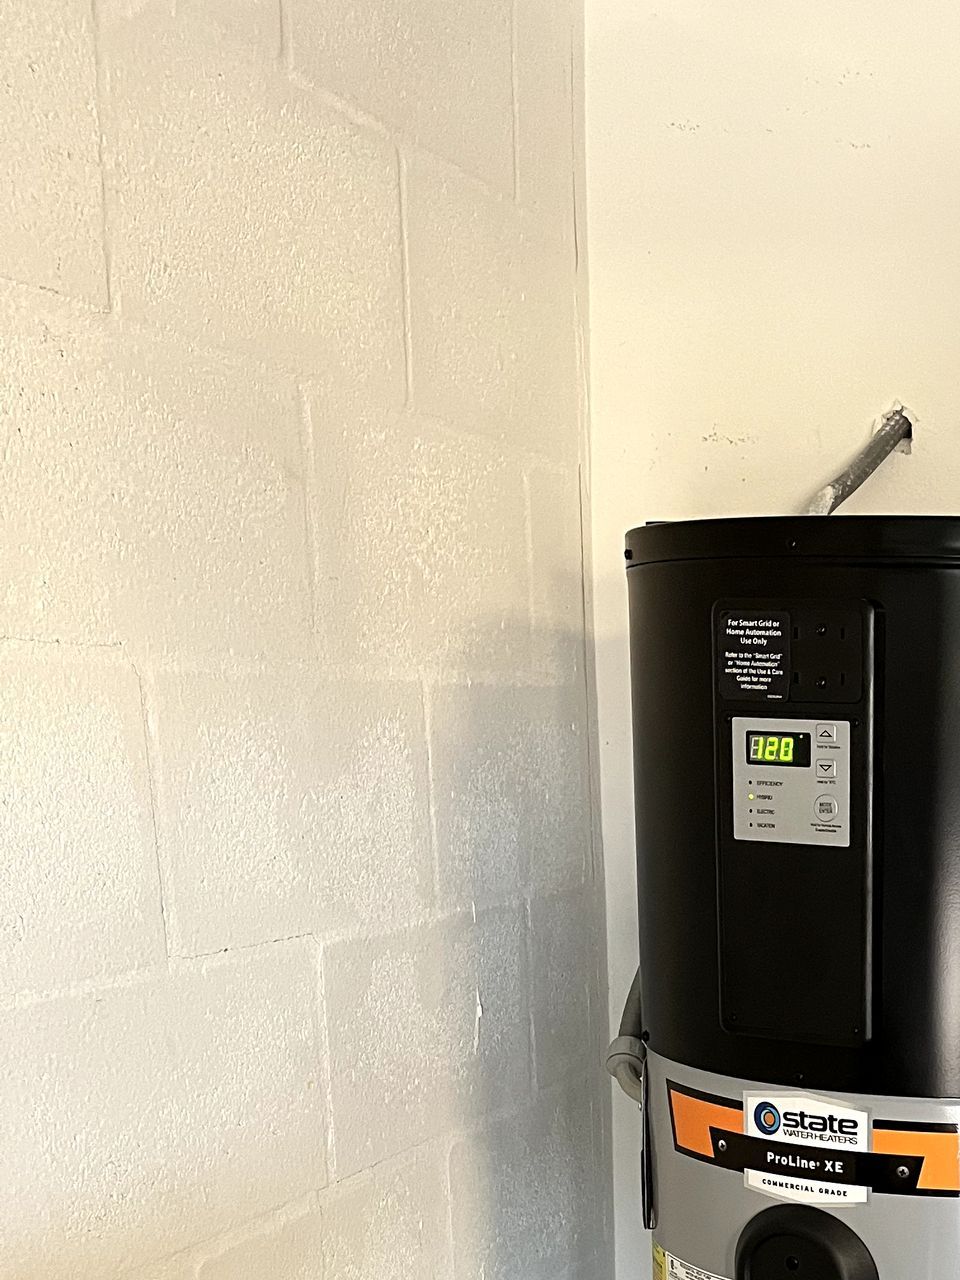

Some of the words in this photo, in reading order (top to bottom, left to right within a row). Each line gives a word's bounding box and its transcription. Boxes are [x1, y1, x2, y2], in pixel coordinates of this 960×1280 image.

[728, 619, 738, 627] For
[739, 619, 757, 627] Smart
[758, 619, 772, 627] Grid
[745, 628, 782, 636] Automation
[752, 637, 767, 646] Only
[757, 736, 794, 762] 120
[783, 1111, 858, 1136] state
[783, 1128, 815, 1140] WATER
[815, 1130, 858, 1145] HEATERS
[824, 1159, 844, 1174] XE
[761, 1178, 814, 1193] COMMERCIAL
[818, 1188, 848, 1197] GRADE
